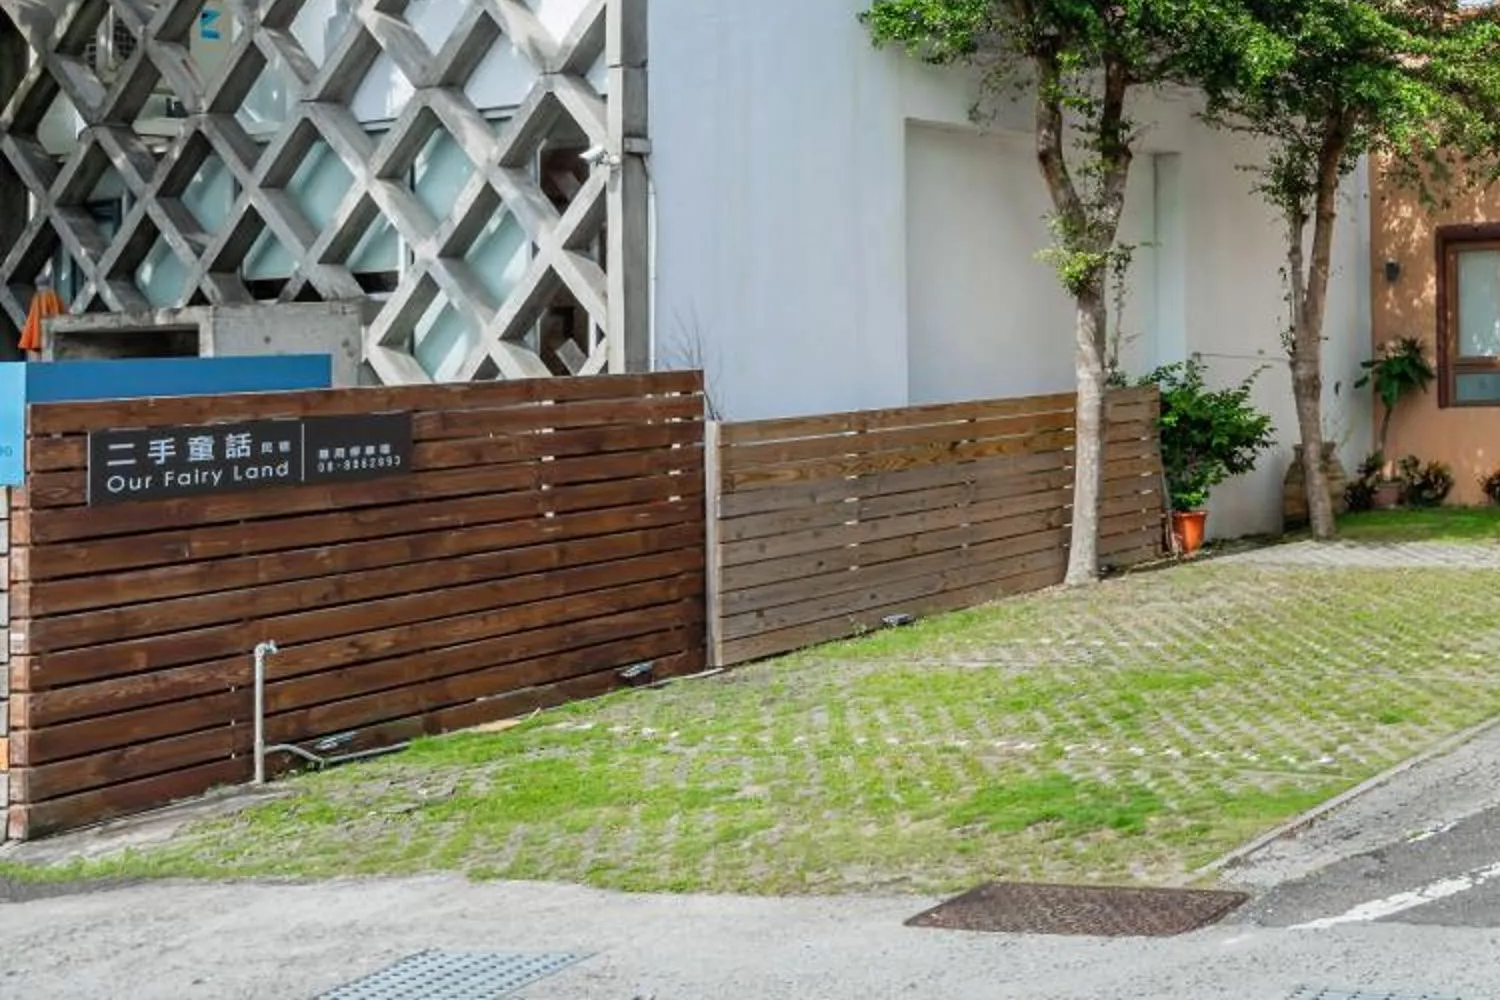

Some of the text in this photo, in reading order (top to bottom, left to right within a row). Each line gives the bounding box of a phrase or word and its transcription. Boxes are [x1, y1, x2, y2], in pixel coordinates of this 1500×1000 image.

[107, 433, 252, 465] 二手童話
[107, 461, 289, 493] Our Fairy Land
